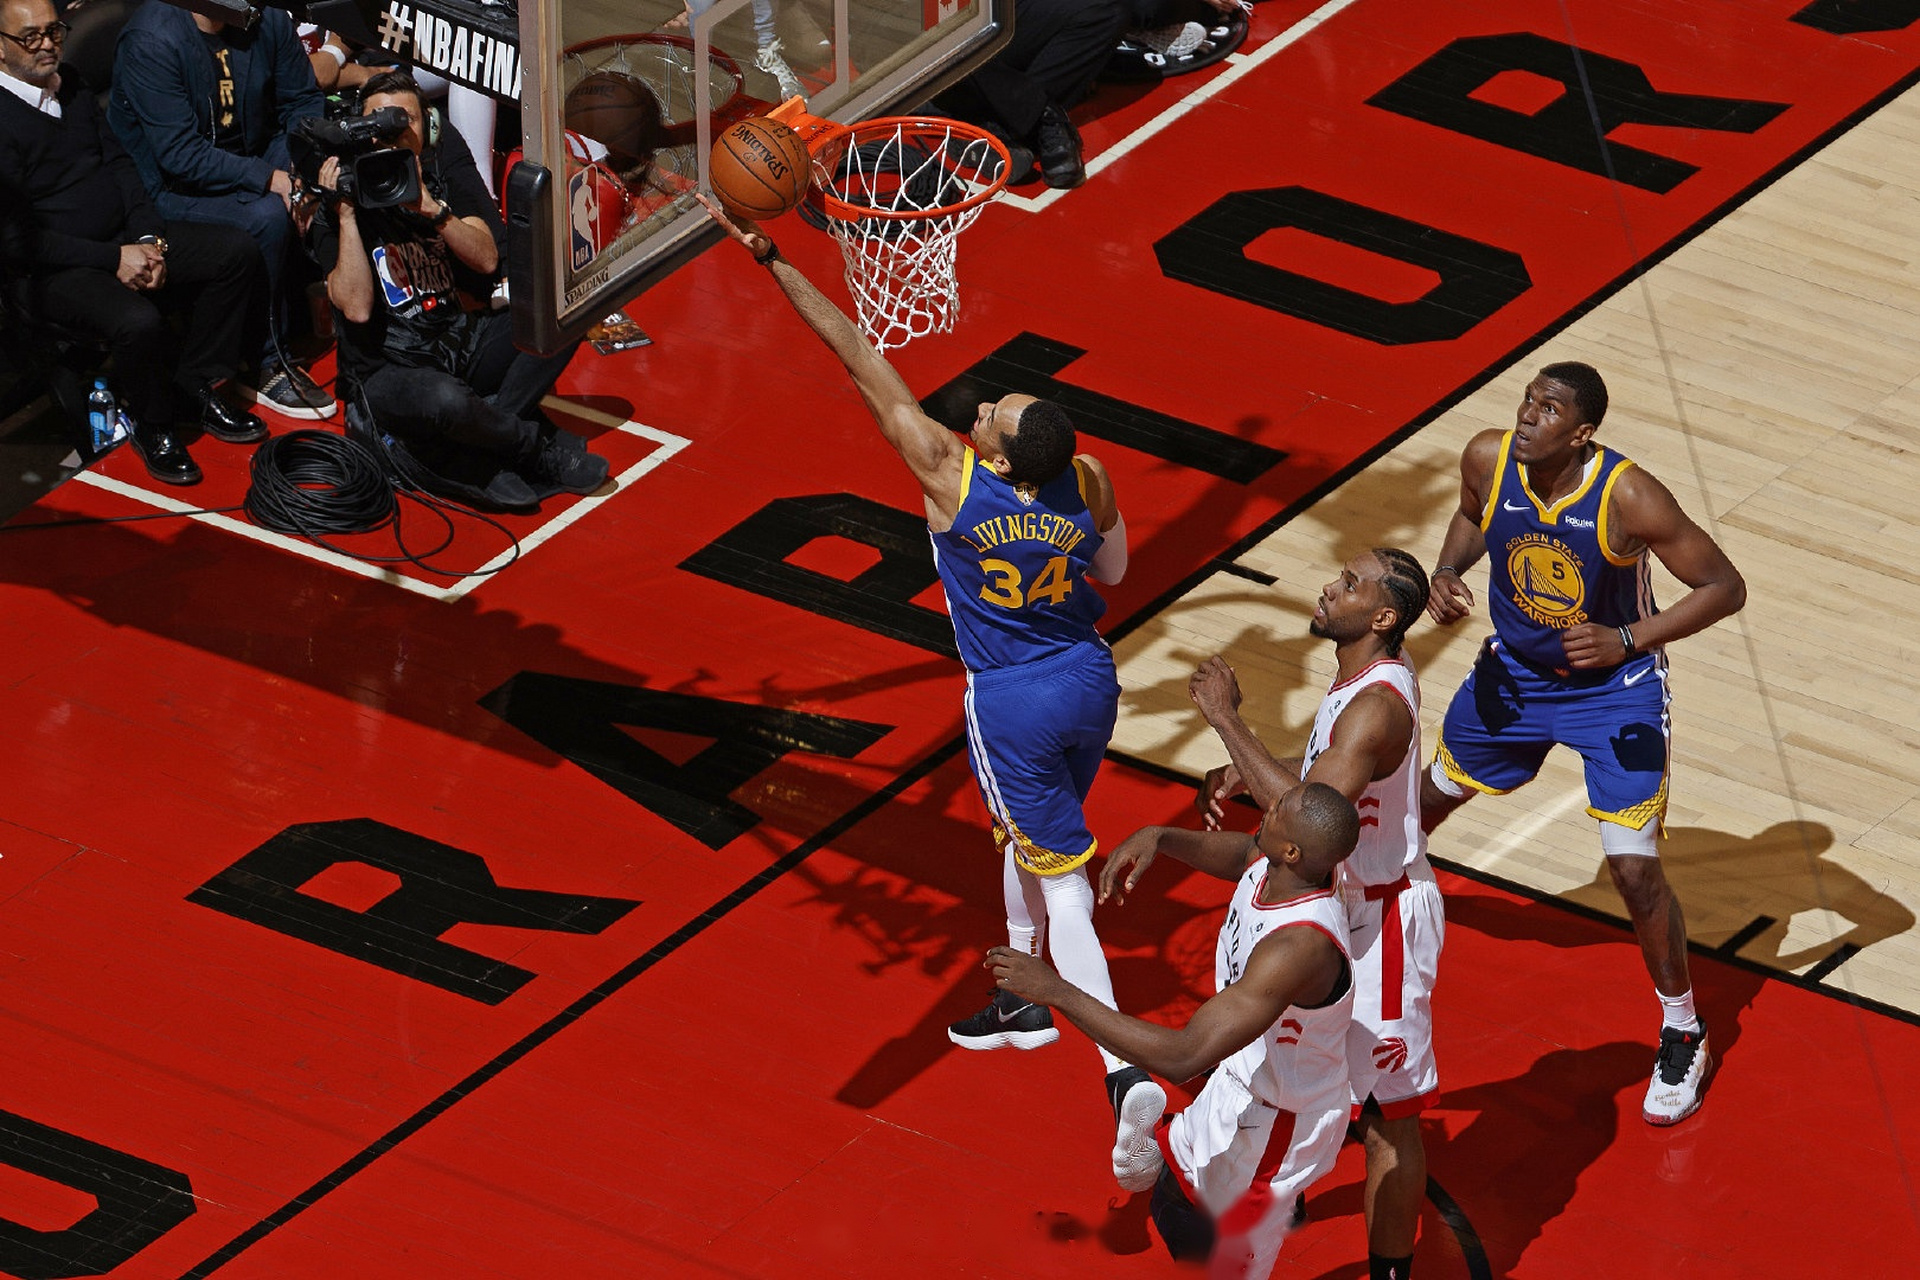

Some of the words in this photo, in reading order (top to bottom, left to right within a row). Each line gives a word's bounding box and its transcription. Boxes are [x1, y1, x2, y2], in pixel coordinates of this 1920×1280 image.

[731, 125, 788, 180] SPALDING
[575, 243, 590, 267] NBA
[564, 266, 610, 309] SPALDING
[186, 0, 1920, 1005] RAPTOR
[1565, 515, 1595, 529] Rakuten
[960, 512, 1085, 555] LIVINGSTON
[1506, 532, 1549, 551] GOLDEN
[1553, 538, 1585, 568] STATE
[978, 556, 1072, 609] 34
[1552, 561, 1565, 580] 5
[1512, 593, 1589, 629] WARRIORS
